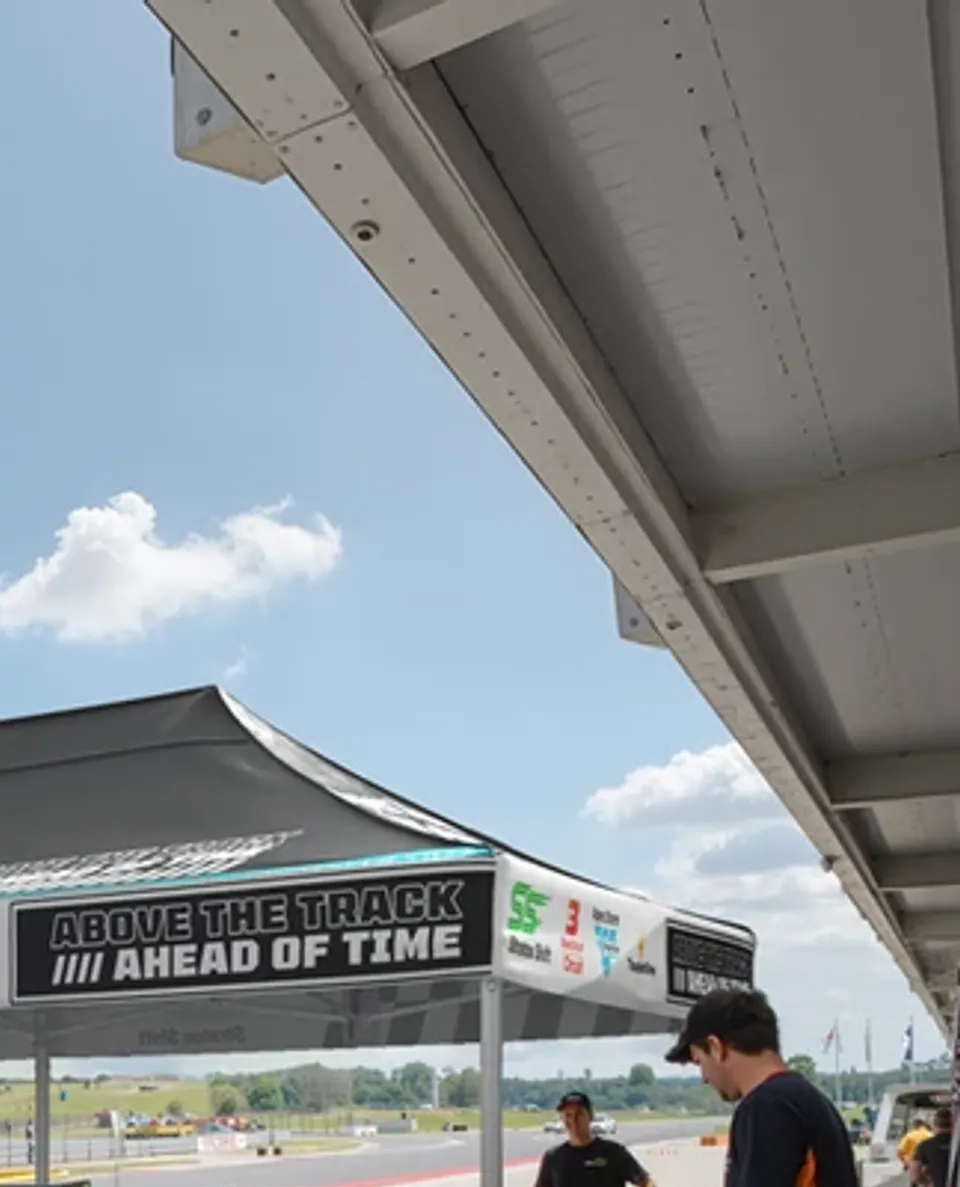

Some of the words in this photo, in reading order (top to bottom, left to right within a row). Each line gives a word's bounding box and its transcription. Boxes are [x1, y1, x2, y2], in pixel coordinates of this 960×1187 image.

[49, 902, 192, 949] ABOVE
[200, 894, 288, 938] THE
[296, 879, 466, 930] TRACK
[112, 939, 260, 982] AHEAD
[271, 934, 330, 971] OF
[343, 924, 463, 965] TIME
